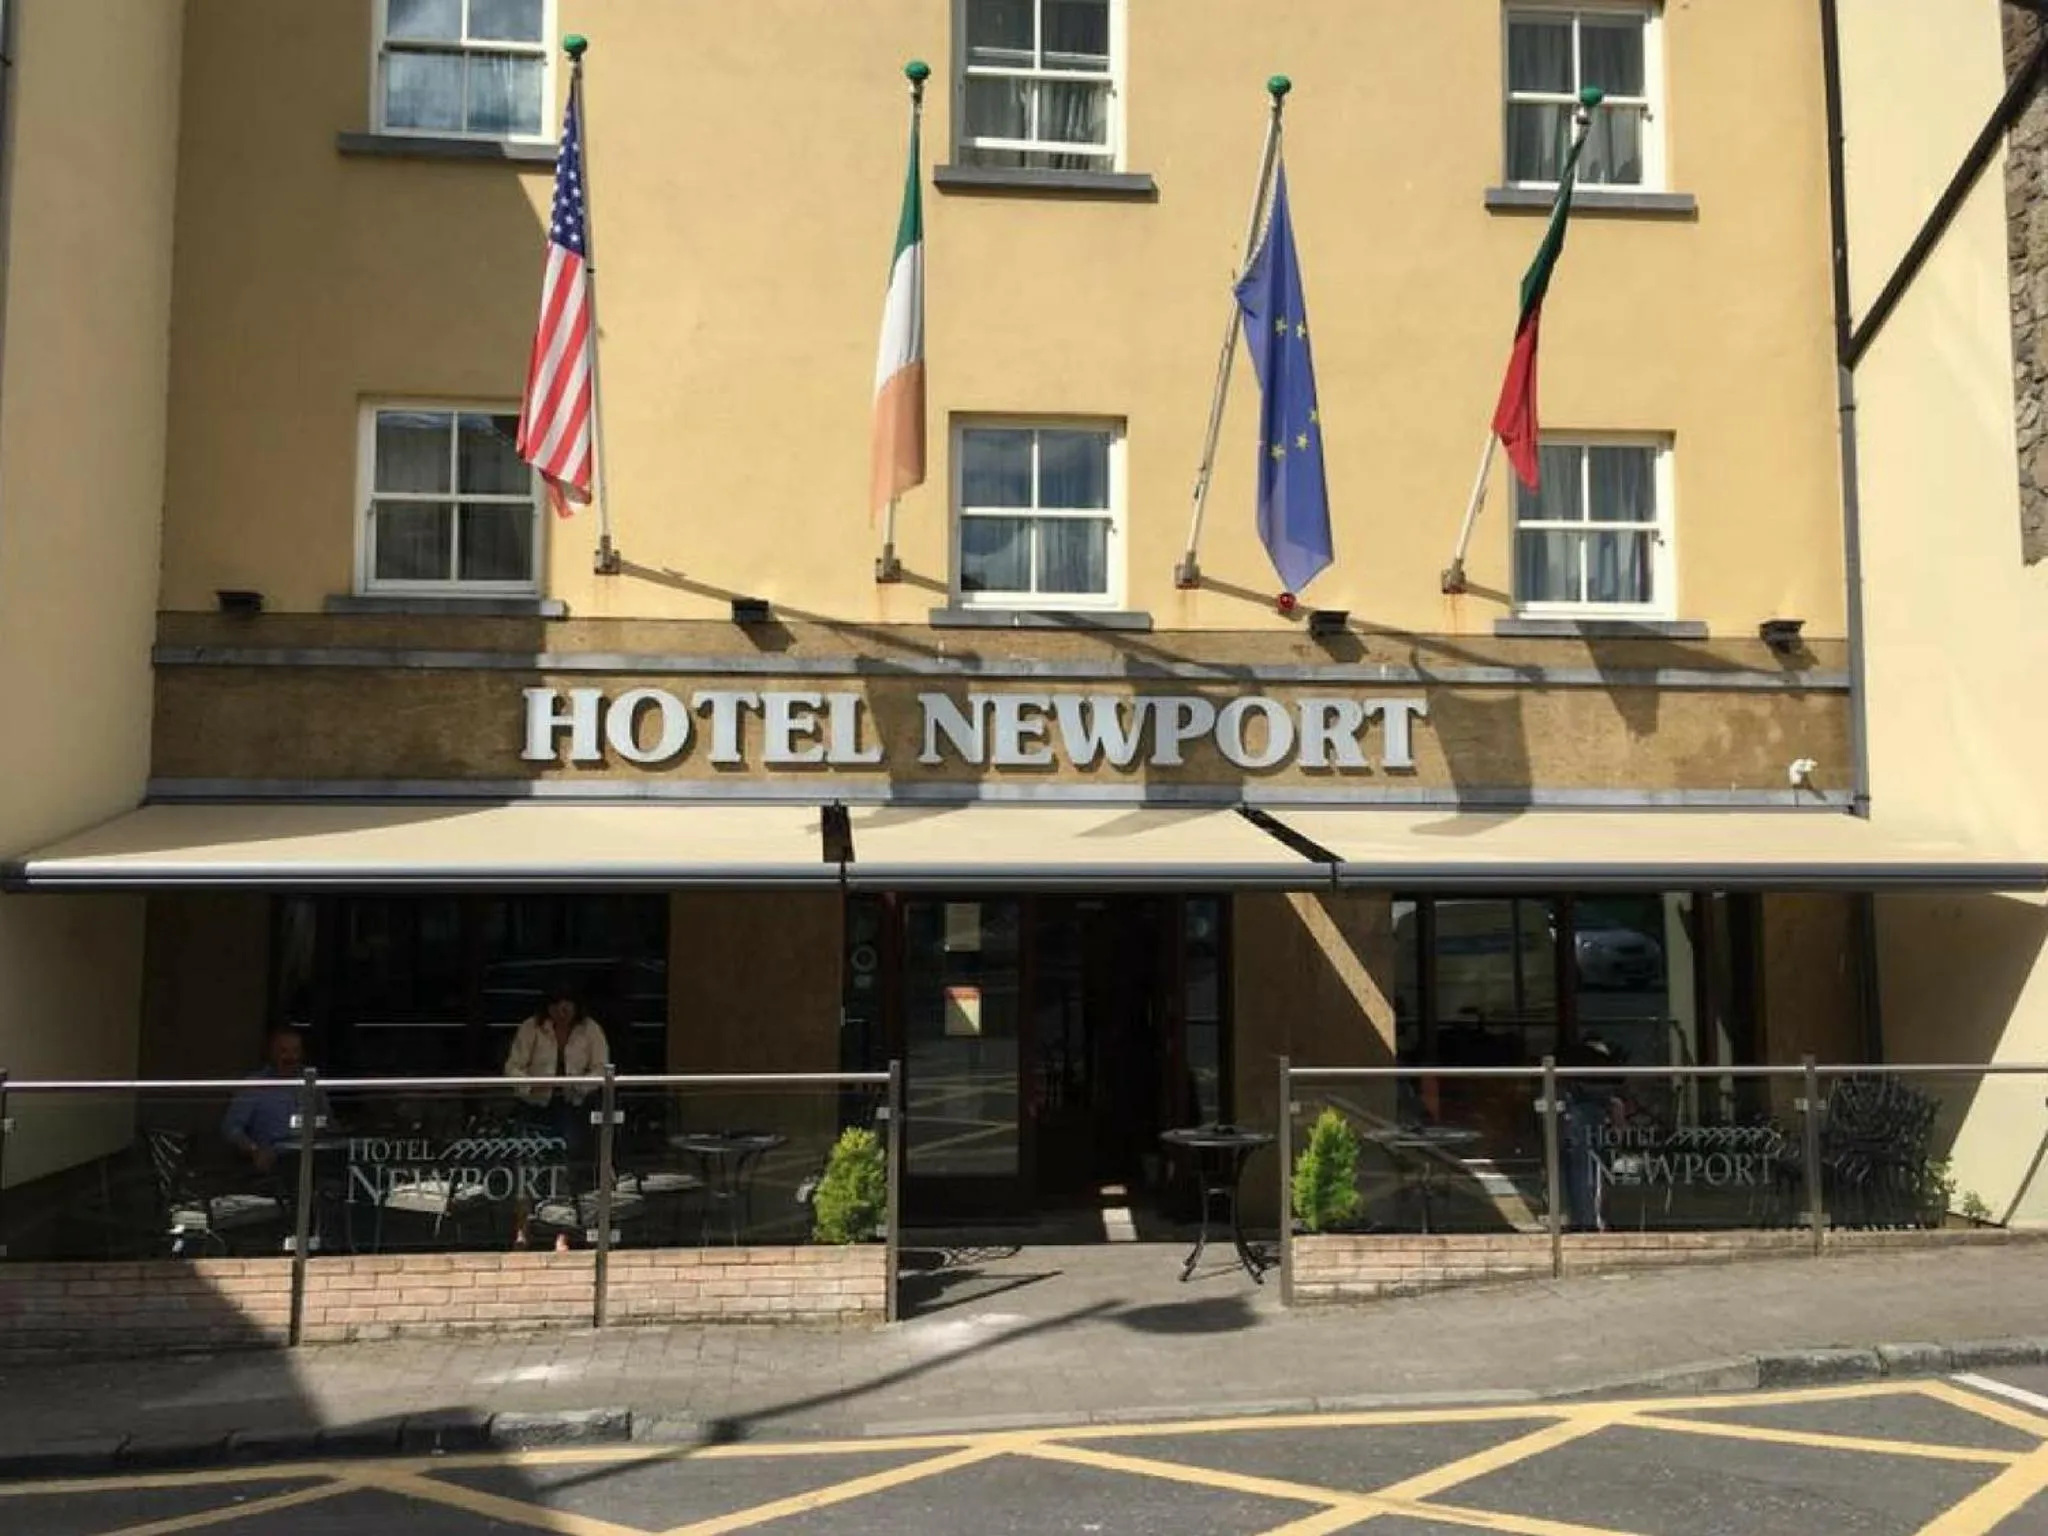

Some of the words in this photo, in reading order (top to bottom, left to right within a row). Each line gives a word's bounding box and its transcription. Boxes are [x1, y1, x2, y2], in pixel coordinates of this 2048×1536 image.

[522, 687, 883, 764] HOTEL
[918, 692, 1429, 768] NEWPORT
[348, 1138, 435, 1161] HOTEL
[1585, 1124, 1658, 1146] HOTEL
[346, 1164, 567, 1205] NEWPORT
